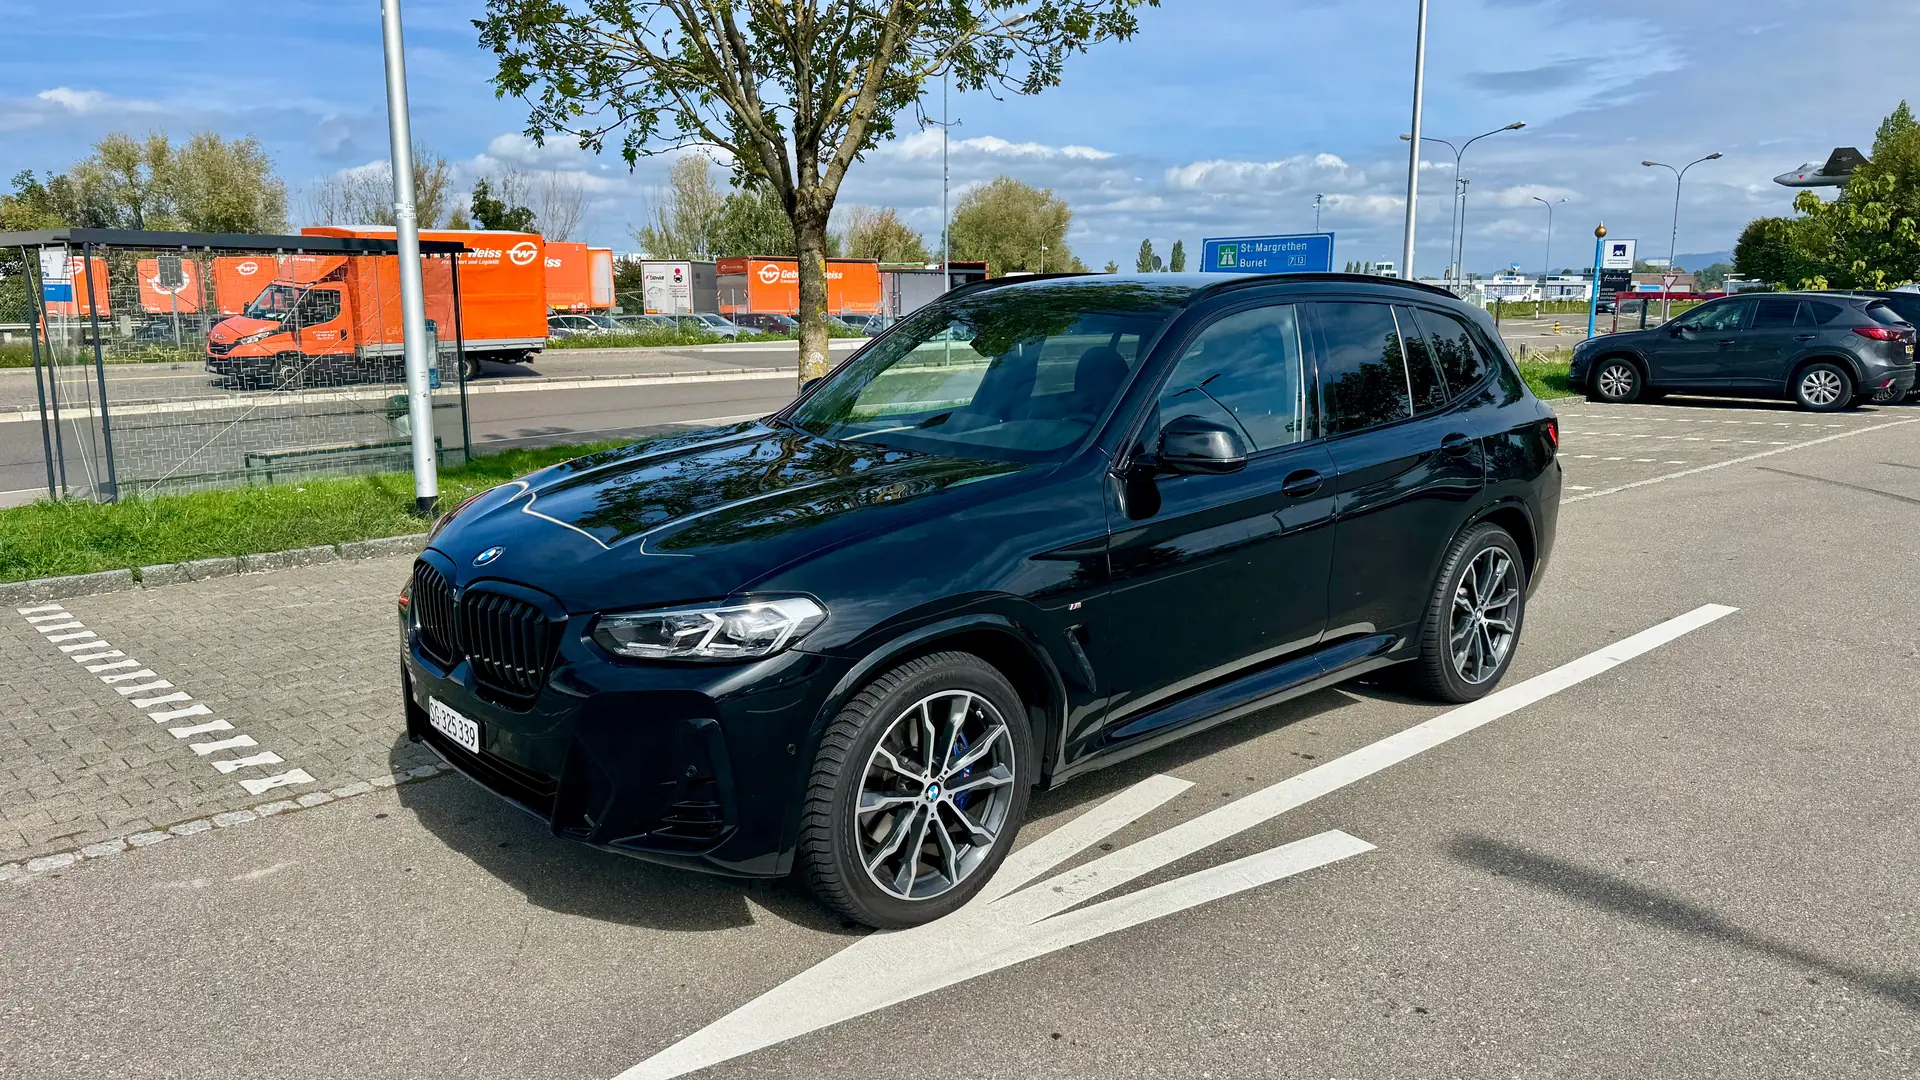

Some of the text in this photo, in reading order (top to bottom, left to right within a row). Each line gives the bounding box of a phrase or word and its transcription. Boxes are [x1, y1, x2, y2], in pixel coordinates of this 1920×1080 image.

[1240, 241, 1307, 254] St. Margrethen
[545, 256, 562, 268] iss
[1239, 258, 1268, 268] Buriet
[824, 271, 844, 280] eiss
